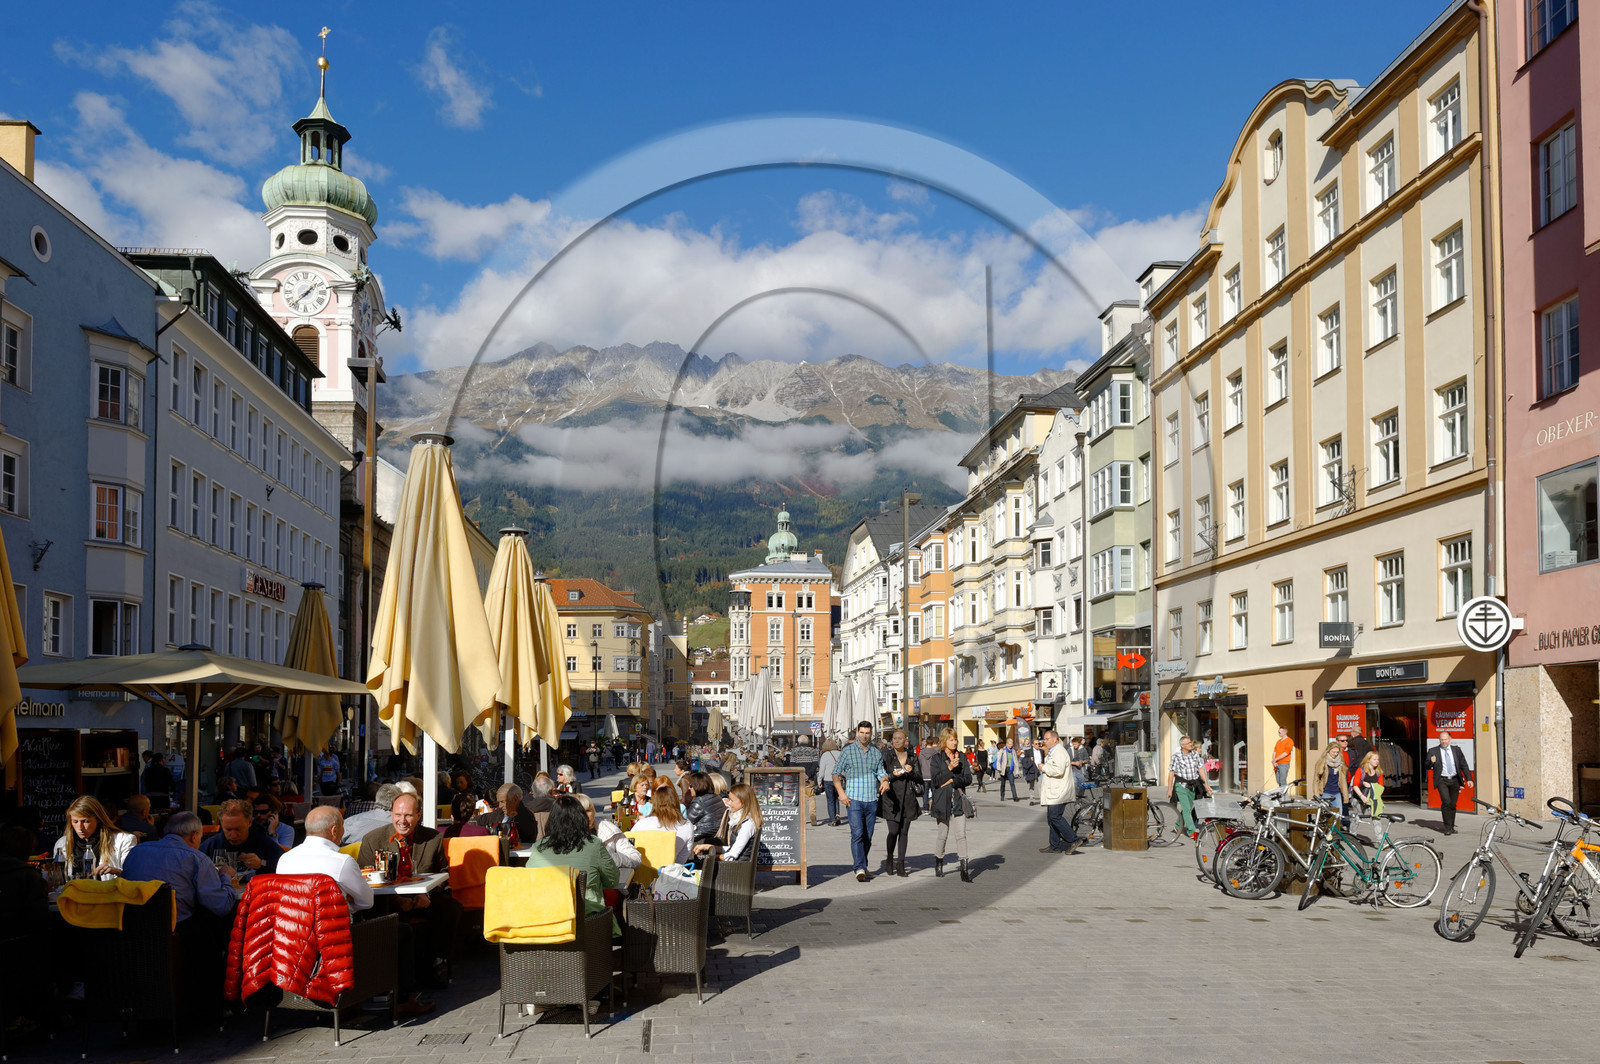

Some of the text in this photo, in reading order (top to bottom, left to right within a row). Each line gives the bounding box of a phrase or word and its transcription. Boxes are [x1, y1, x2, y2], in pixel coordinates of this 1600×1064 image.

[1536, 411, 1599, 446] OBEXER-
[1538, 631, 1560, 651] BUCH
[1562, 626, 1590, 648] PAPIER
[14, 696, 65, 717] ielmann
[1435, 719, 1466, 728] VERKAUF
